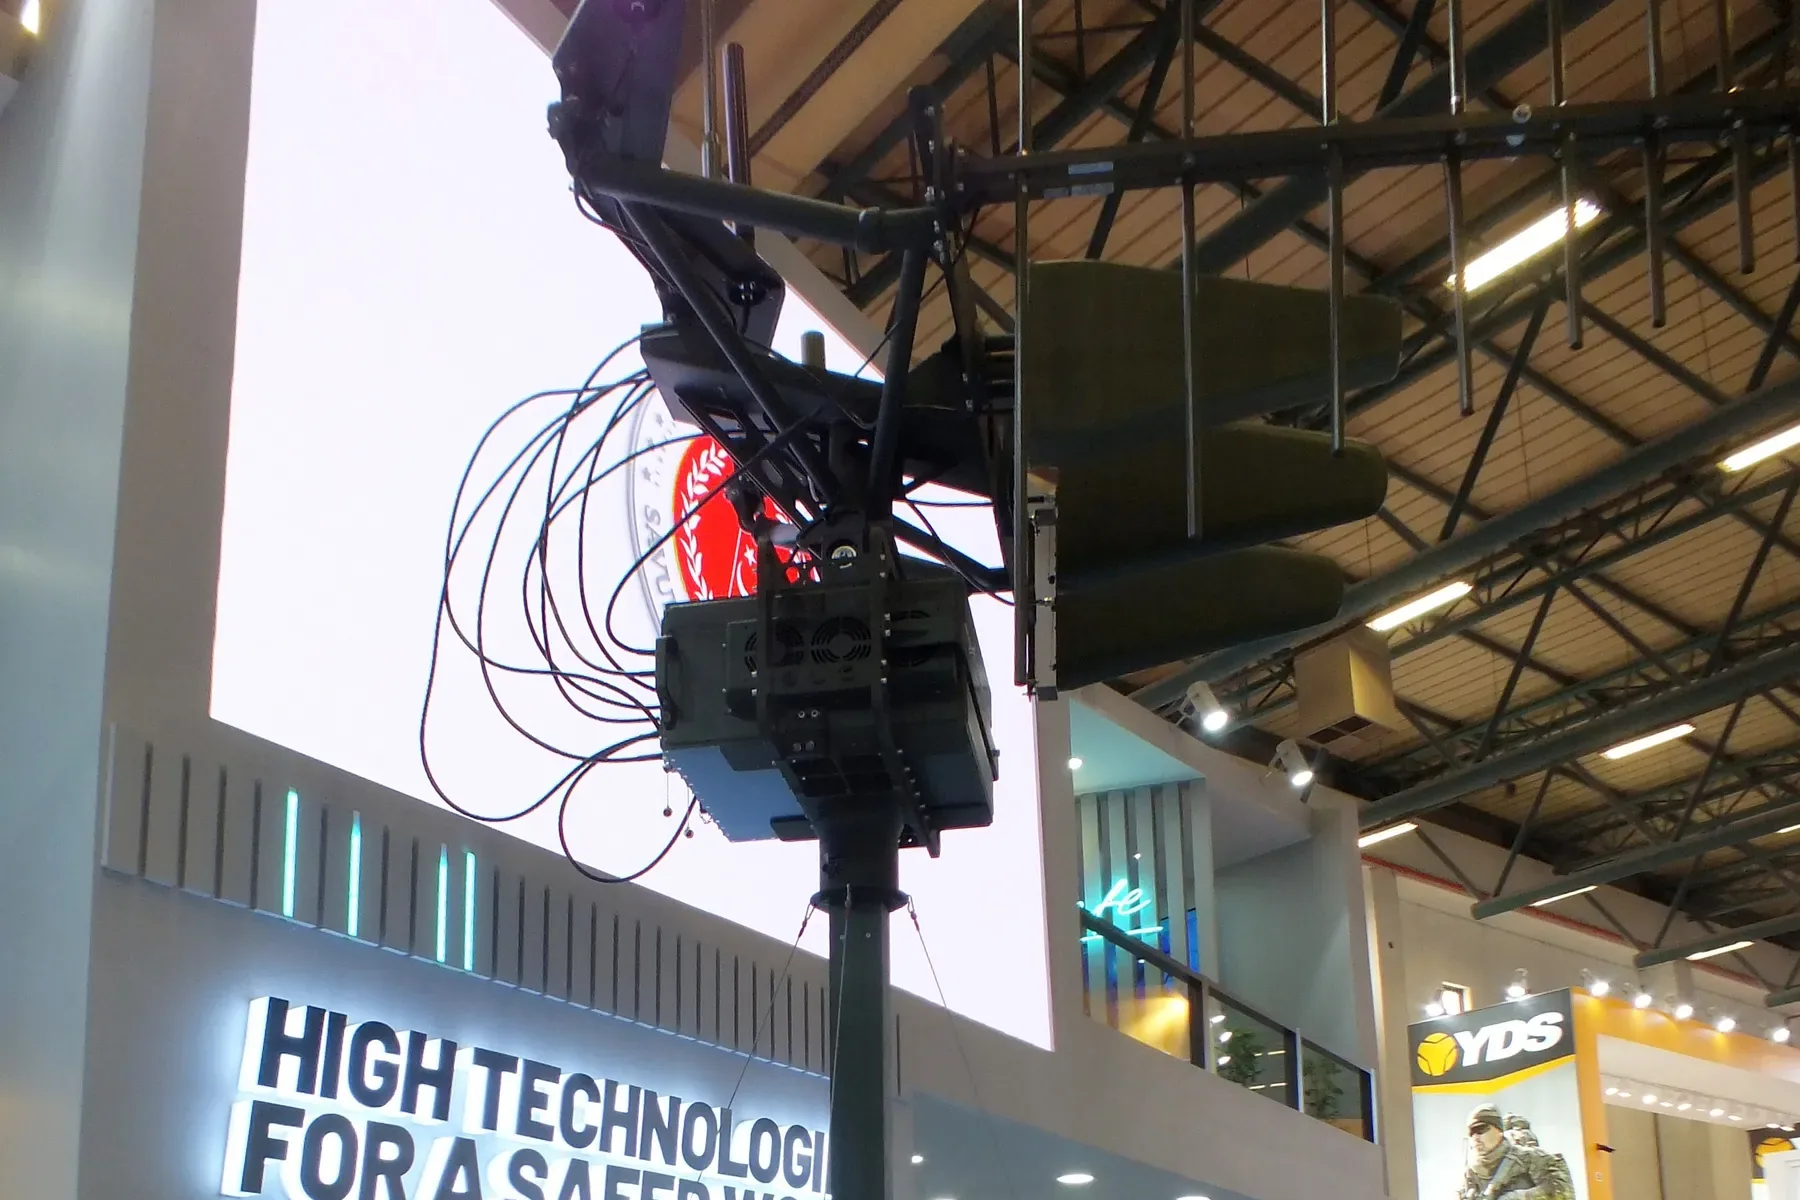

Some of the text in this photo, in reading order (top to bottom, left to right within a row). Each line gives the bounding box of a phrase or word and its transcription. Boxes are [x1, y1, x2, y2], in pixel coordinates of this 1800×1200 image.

[257, 996, 832, 1195] HIGH TECHNOLOGI
[1453, 1011, 1565, 1067] YDS
